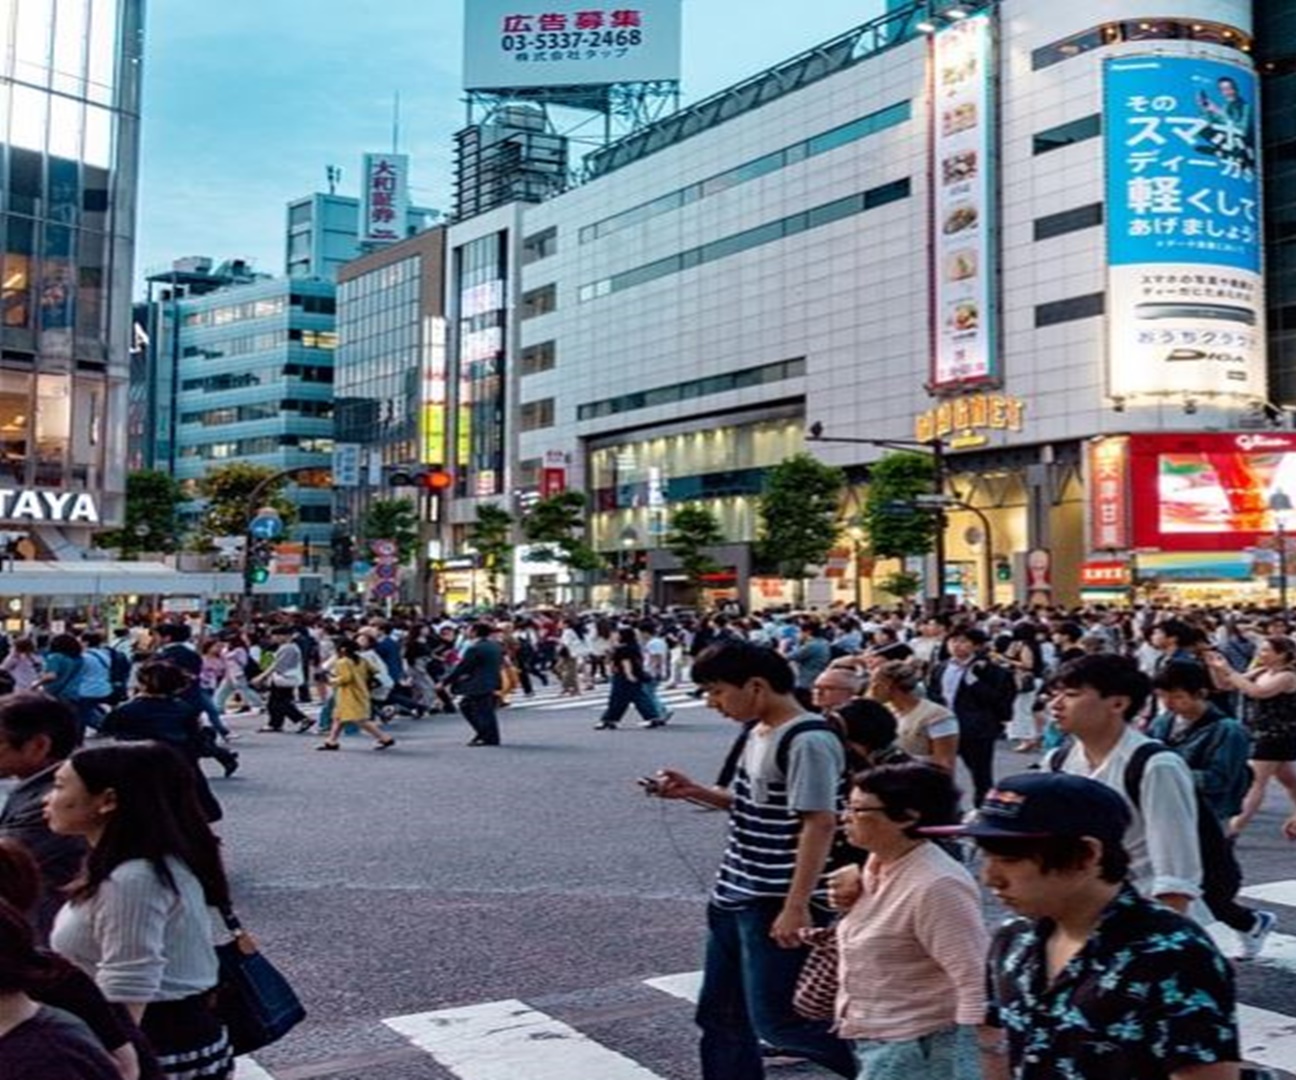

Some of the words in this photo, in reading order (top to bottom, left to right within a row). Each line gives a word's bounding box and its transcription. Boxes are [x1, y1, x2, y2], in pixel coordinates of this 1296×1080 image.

[503, 9, 642, 33] 広告募集
[501, 30, 642, 51] 03-5337-2468
[1125, 95, 1177, 113] その
[1126, 176, 1256, 222] 軽くして
[915, 393, 1025, 444] MAGNET
